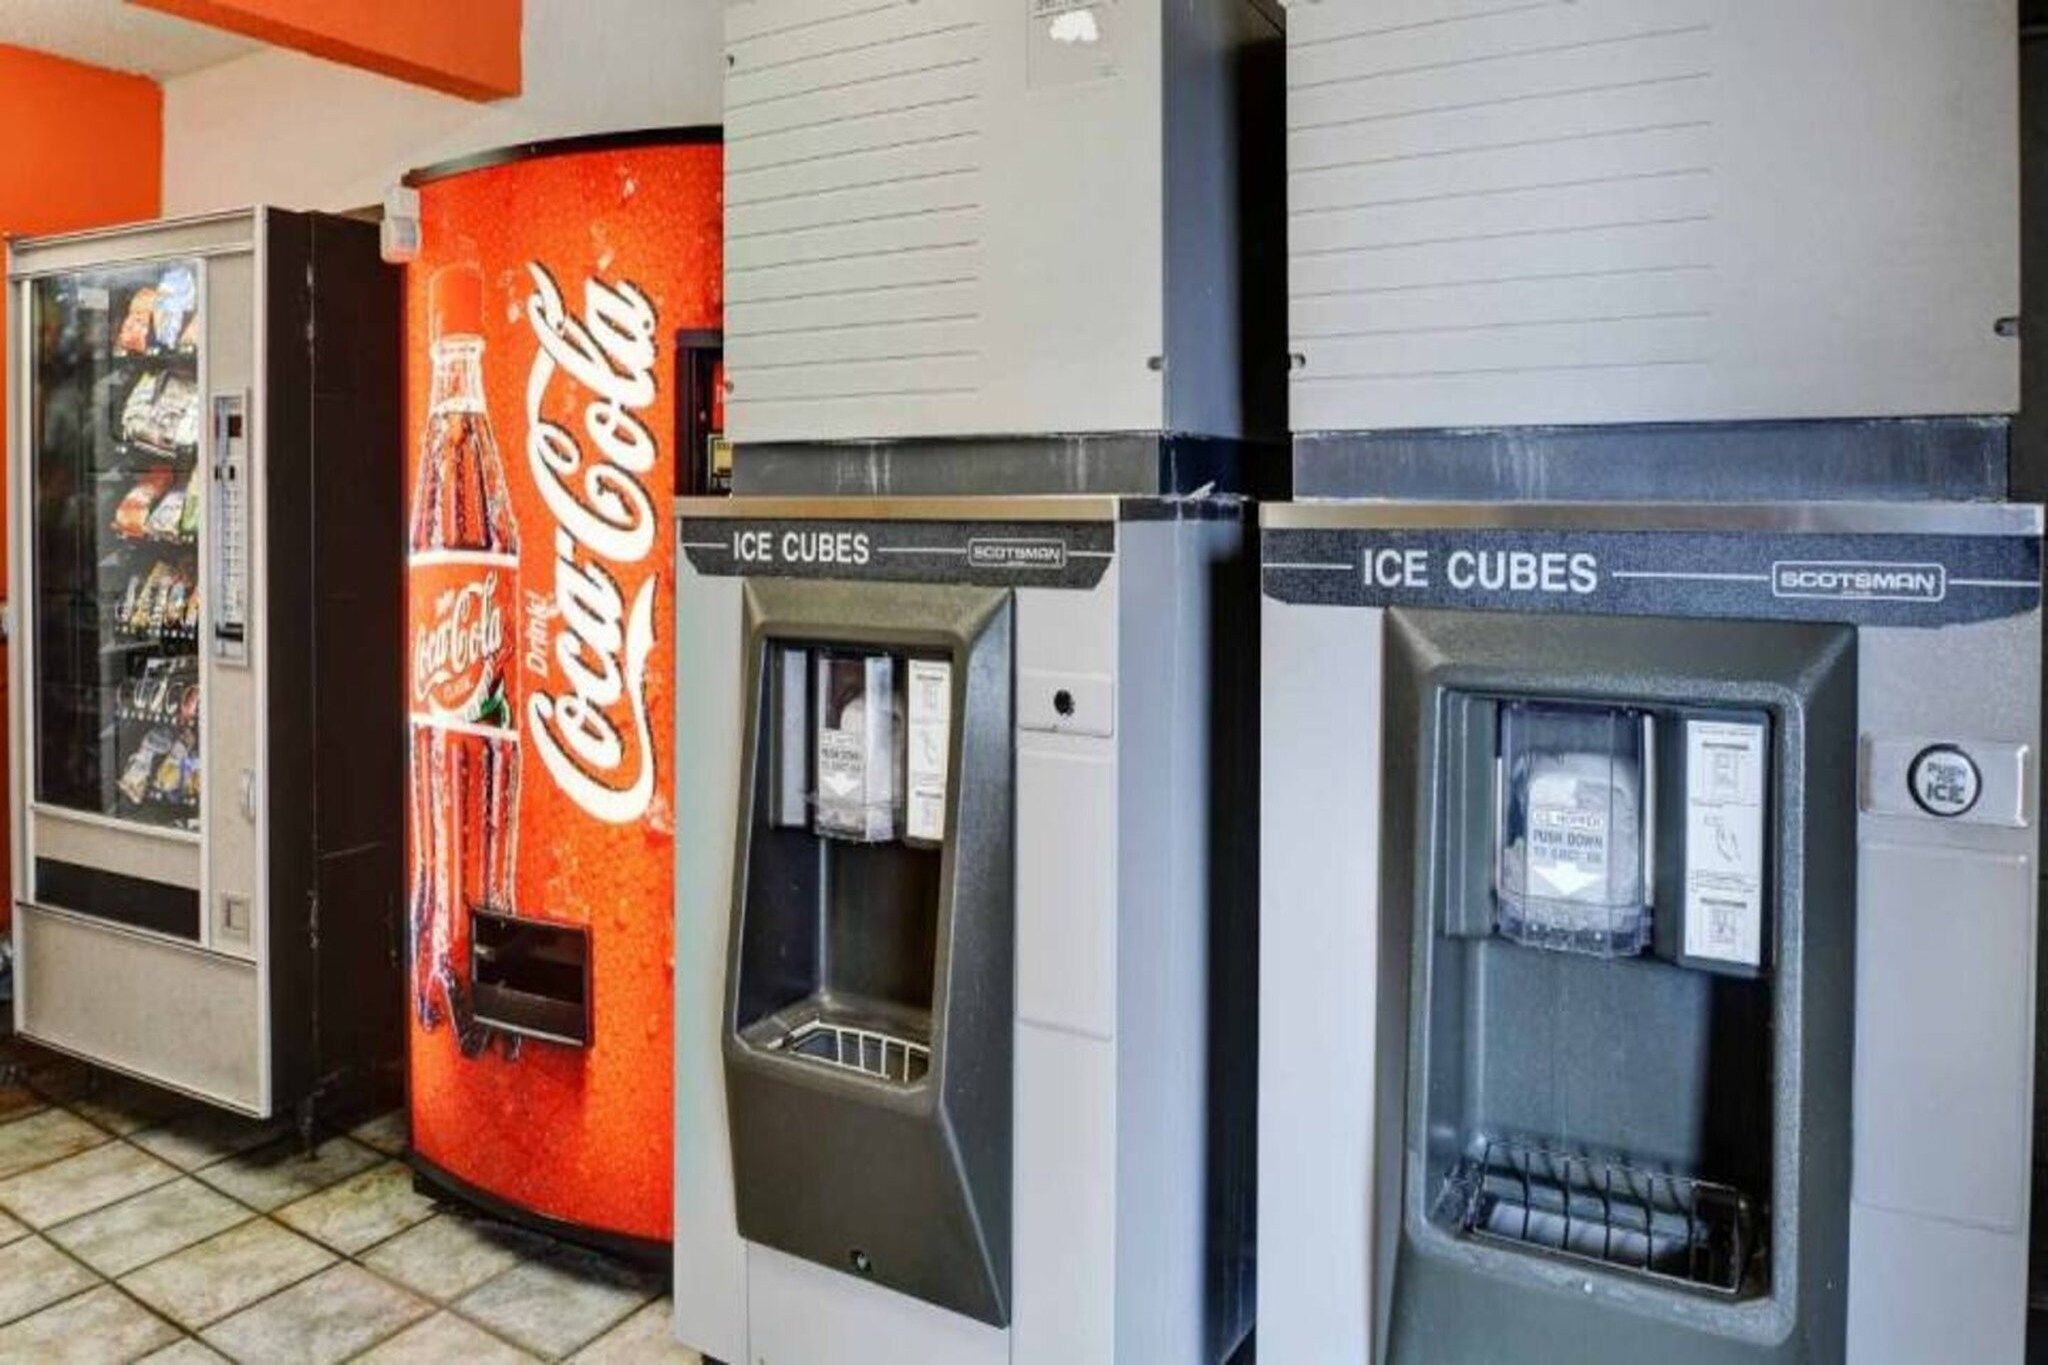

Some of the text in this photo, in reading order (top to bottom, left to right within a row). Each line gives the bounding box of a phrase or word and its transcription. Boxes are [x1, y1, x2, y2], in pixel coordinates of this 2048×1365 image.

[527, 259, 659, 823] Coca-Cola
[733, 531, 870, 565] ICE CUBES
[973, 545, 1062, 564] SCOTSMAN
[1363, 548, 1599, 594] ICE CUBES
[1781, 570, 1937, 597] SCOTSMAN
[1926, 782, 1965, 804] ICE
